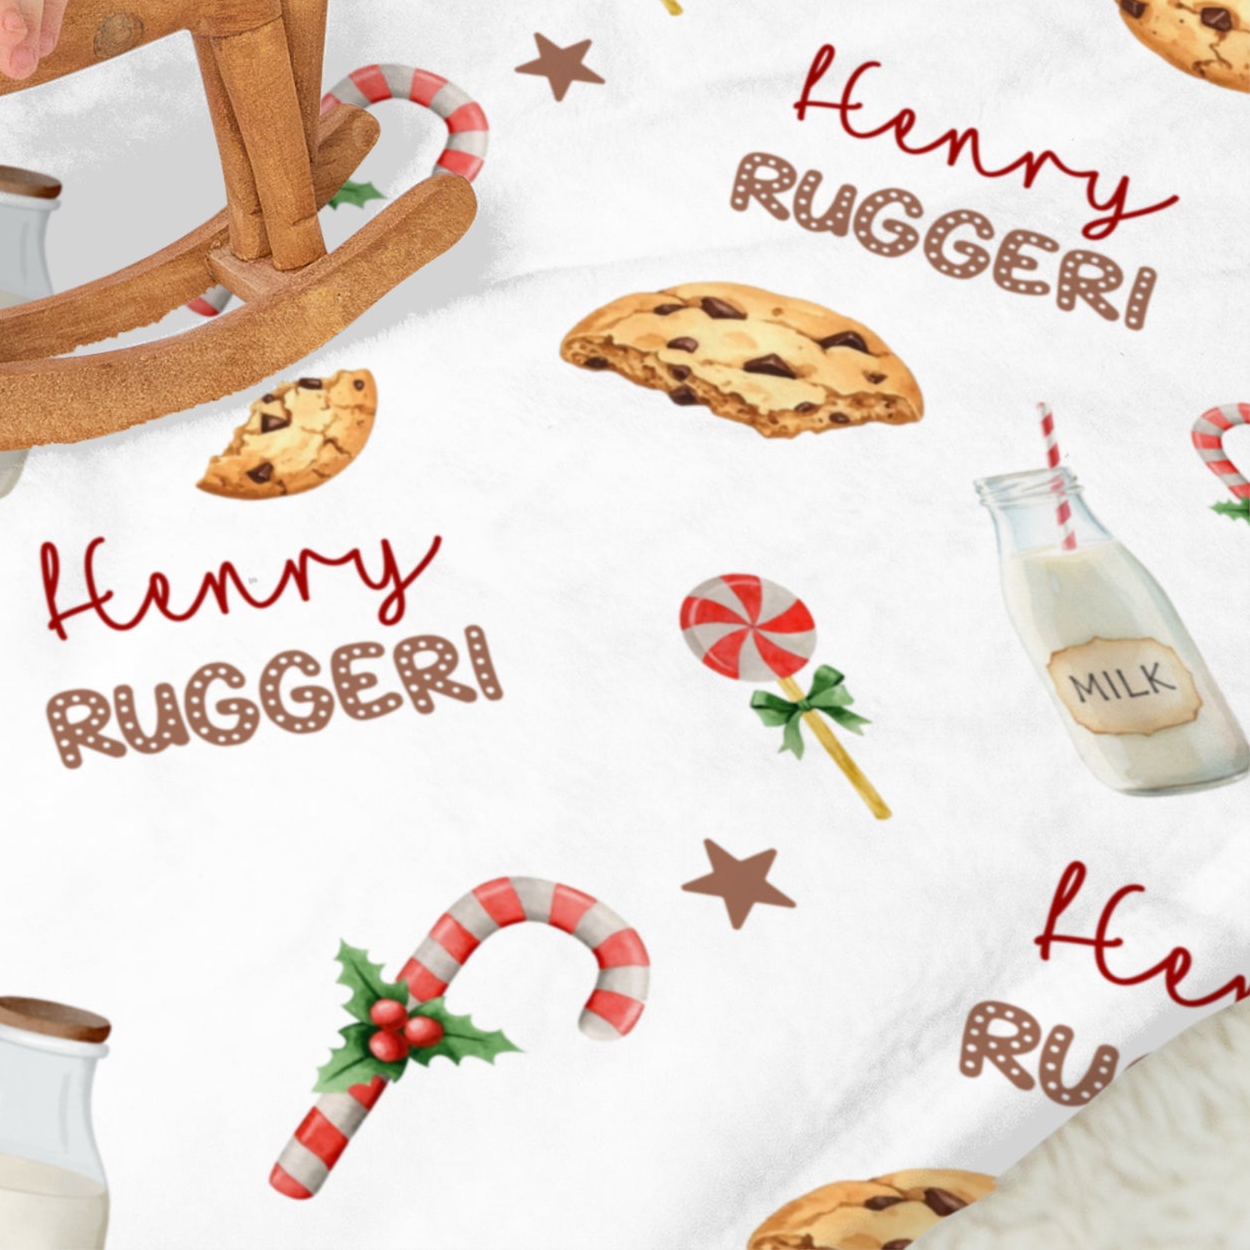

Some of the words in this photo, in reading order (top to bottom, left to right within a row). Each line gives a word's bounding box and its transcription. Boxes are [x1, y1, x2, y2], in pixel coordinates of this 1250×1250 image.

[792, 43, 1180, 241] Henry
[730, 151, 1158, 332] RUGGERI
[40, 534, 443, 642] Henry
[46, 624, 504, 770] RUGGERI
[1068, 662, 1177, 703] MILK
